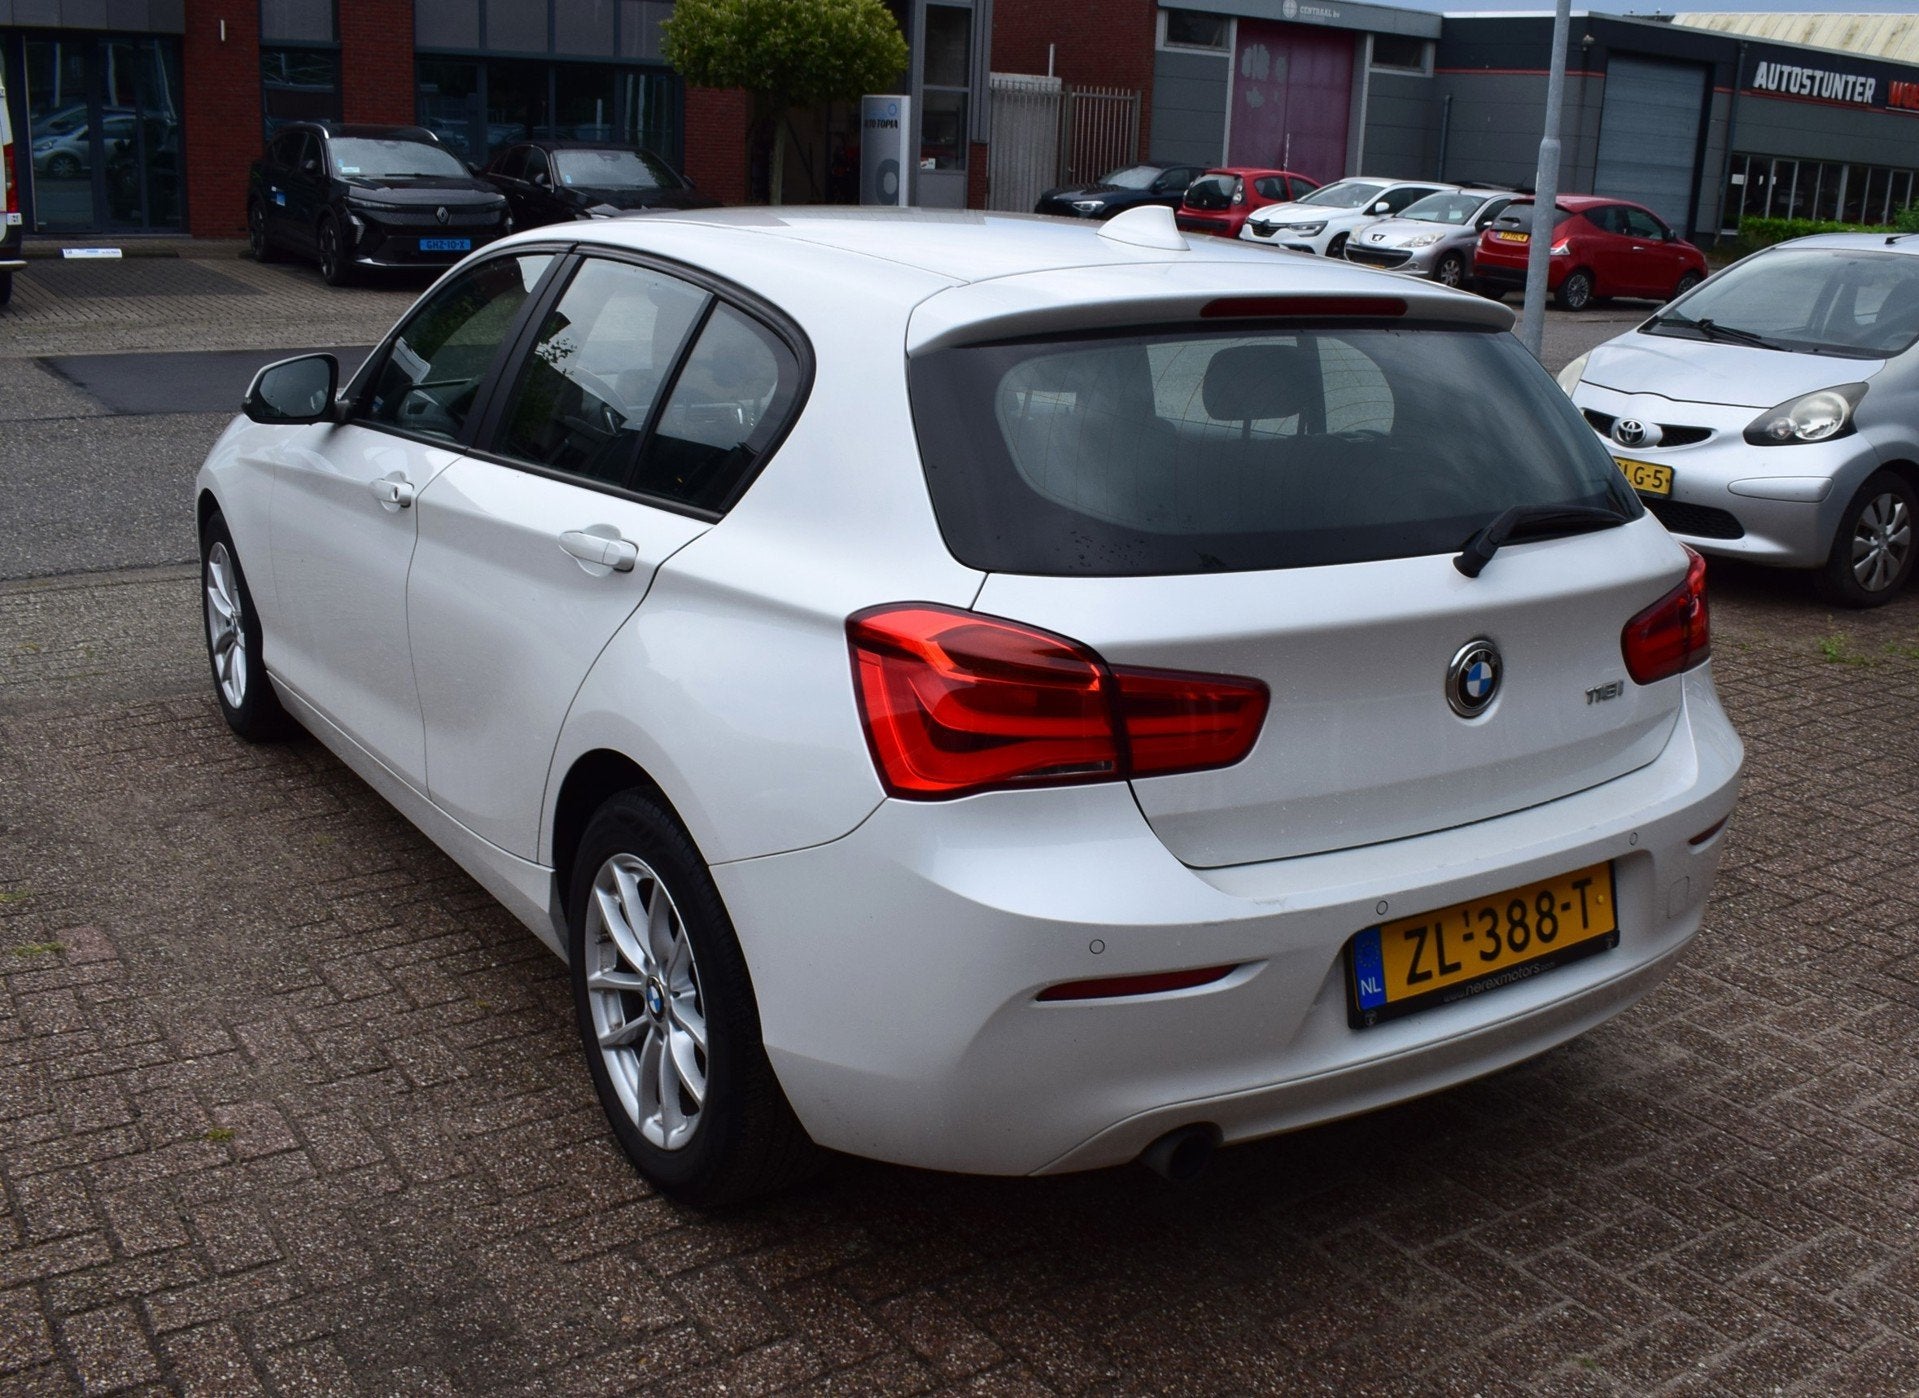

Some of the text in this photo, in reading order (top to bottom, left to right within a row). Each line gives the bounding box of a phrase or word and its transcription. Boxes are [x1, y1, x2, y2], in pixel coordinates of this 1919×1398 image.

[1753, 61, 1876, 103] AUTOSTUNTER
[1403, 877, 1593, 986] ZL-388-T
[1360, 976, 1382, 996] NL
